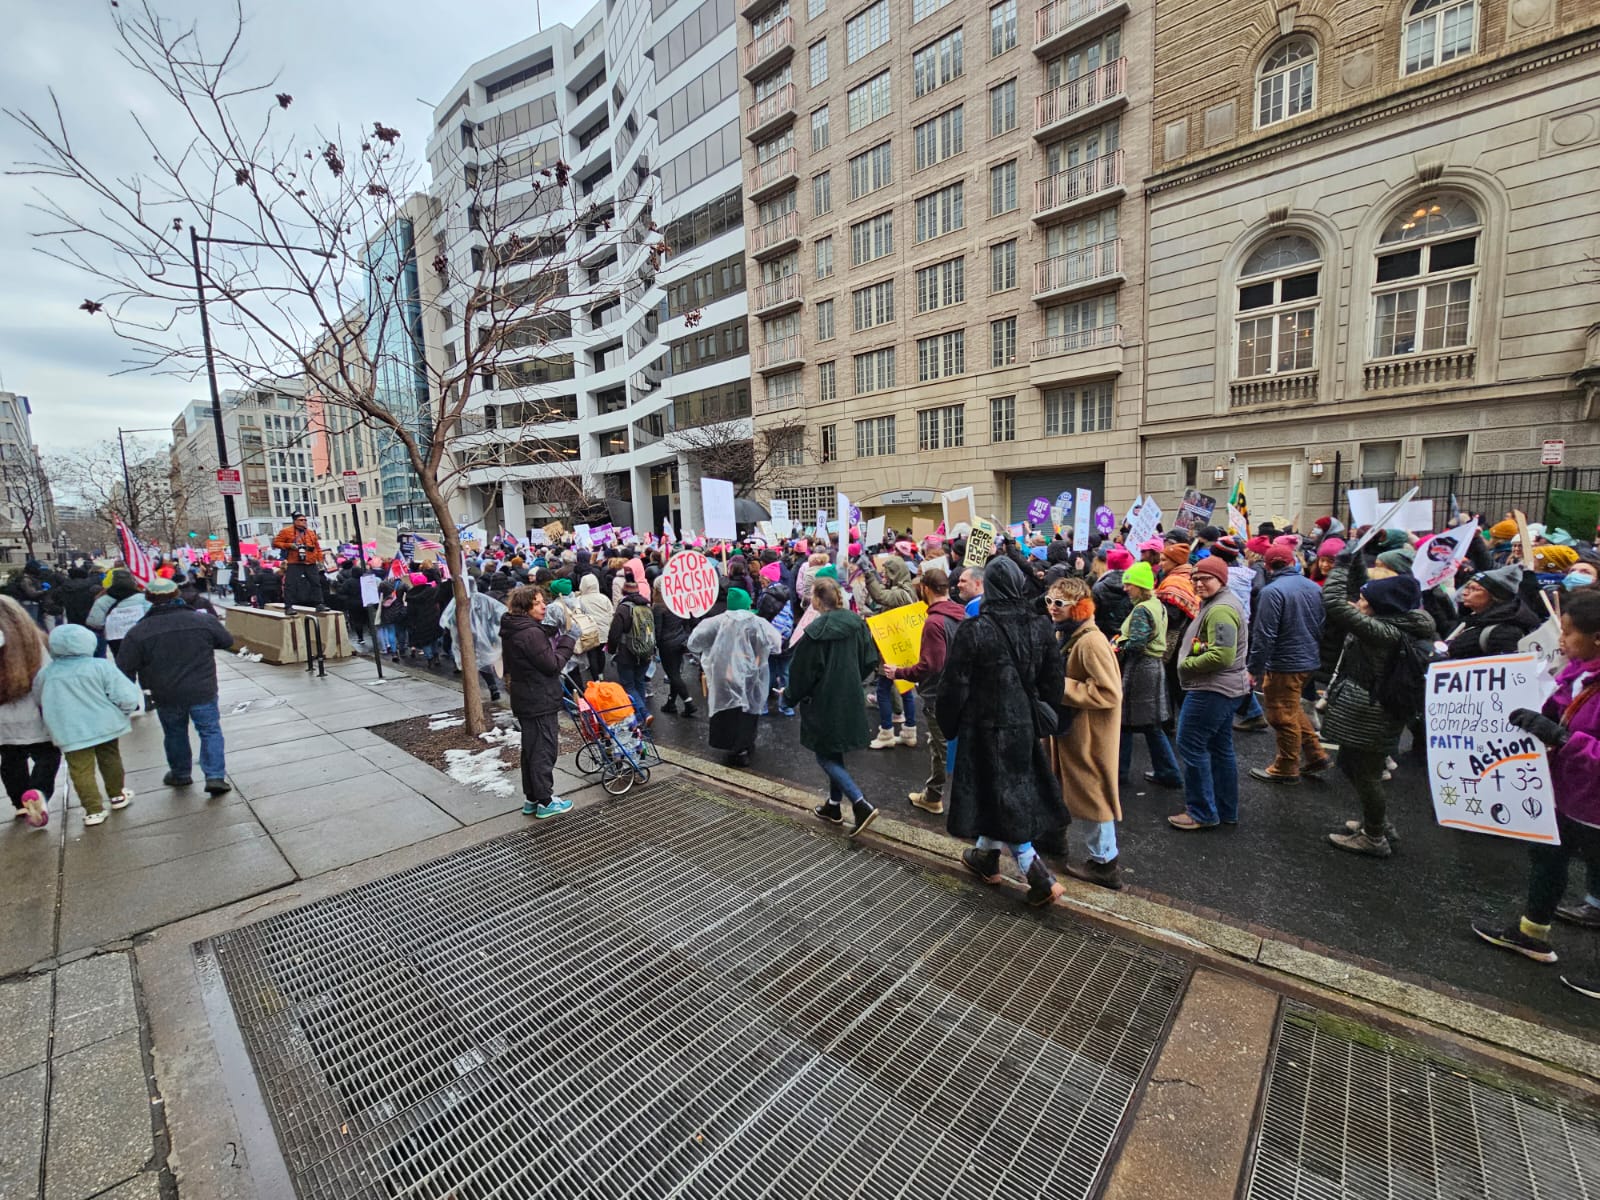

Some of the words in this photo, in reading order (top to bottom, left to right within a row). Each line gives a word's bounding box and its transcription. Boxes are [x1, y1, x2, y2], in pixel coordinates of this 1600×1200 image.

[670, 552, 707, 574] STOP
[664, 568, 716, 597] RACISM
[672, 589, 713, 615] NOW
[1434, 667, 1506, 694] FAITH
[1511, 672, 1526, 686] is
[1428, 694, 1485, 720] empathy
[1490, 692, 1503, 713] &
[1430, 735, 1474, 750] FAITH
[1469, 737, 1536, 776] Action
